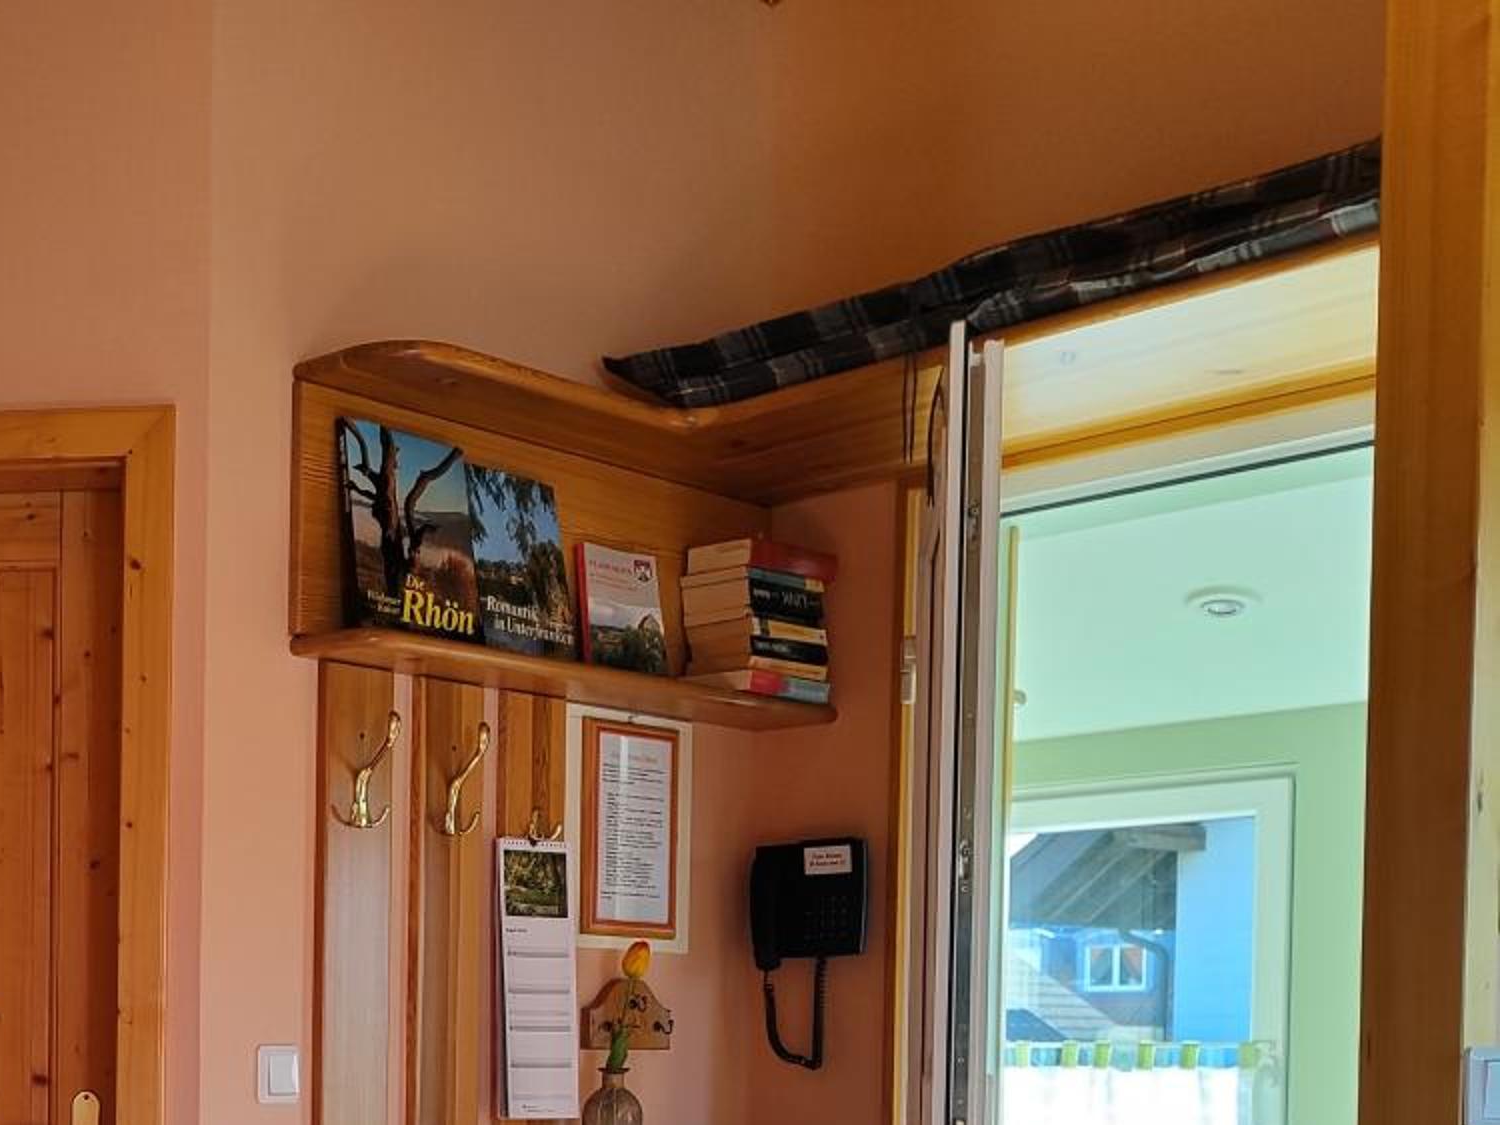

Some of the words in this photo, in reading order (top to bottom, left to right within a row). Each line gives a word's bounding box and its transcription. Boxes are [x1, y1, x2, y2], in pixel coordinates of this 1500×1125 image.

[405, 574, 426, 590] Die
[403, 590, 474, 635] Rhön
[487, 595, 539, 622] Romantik
